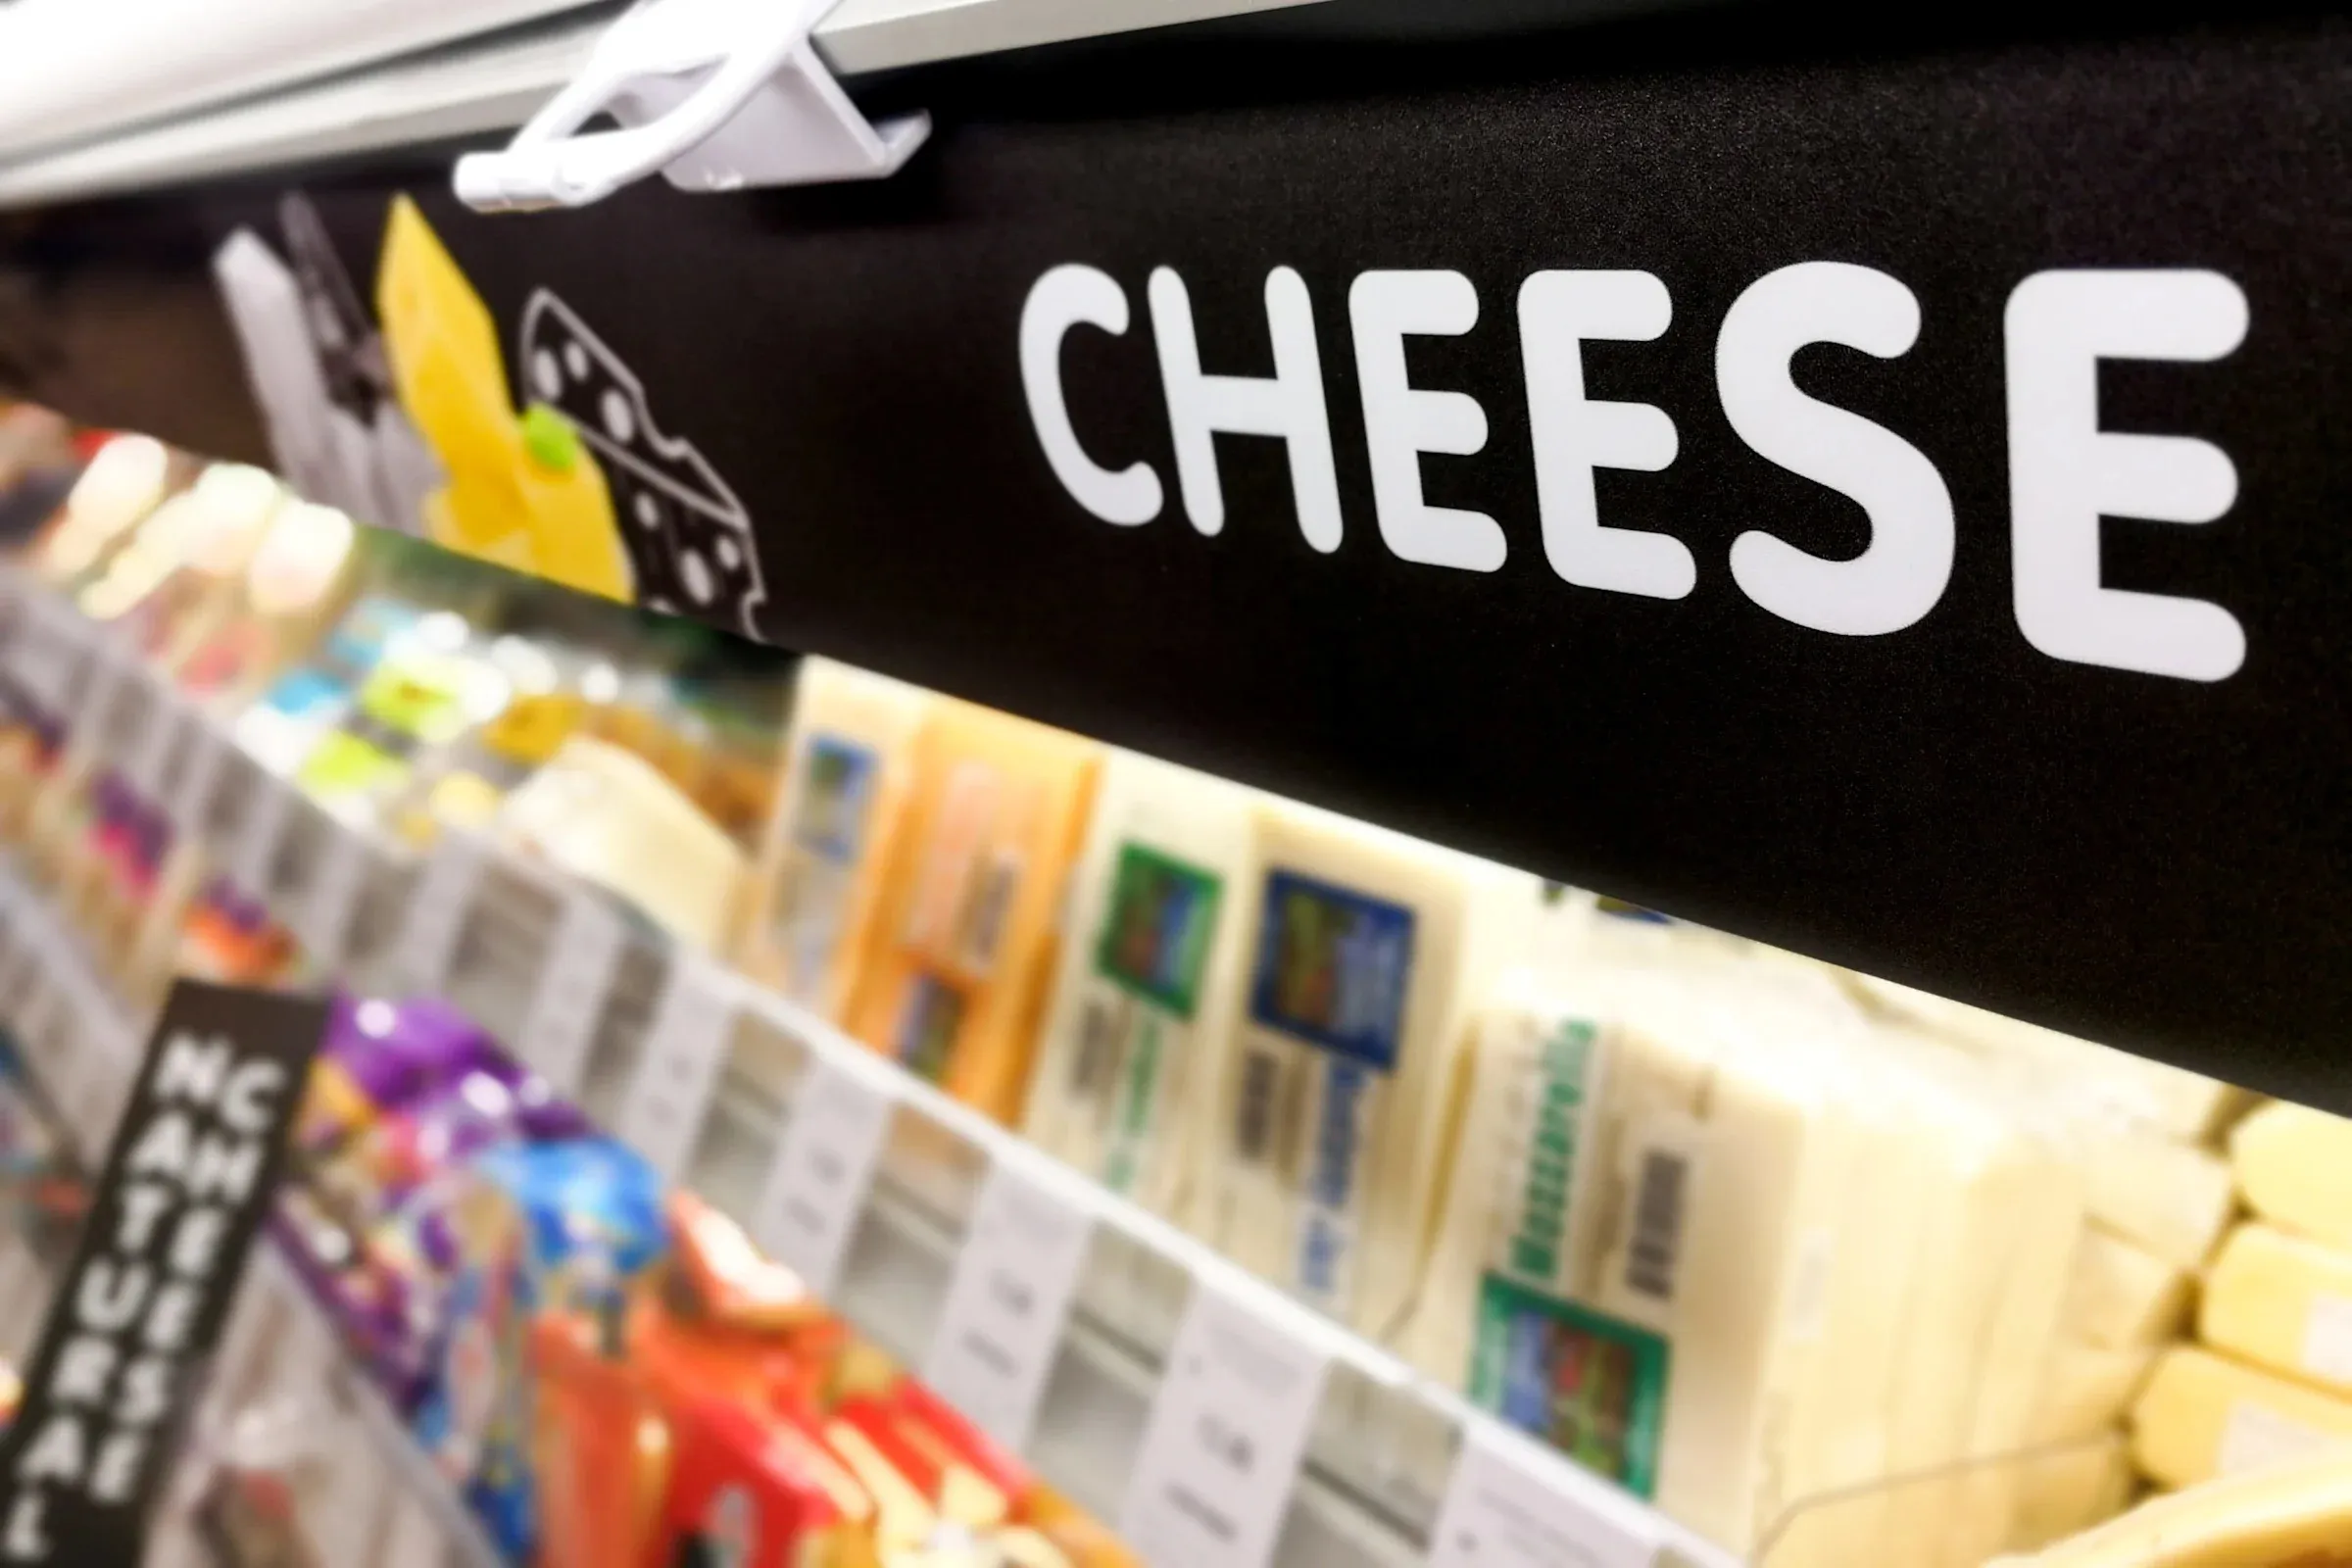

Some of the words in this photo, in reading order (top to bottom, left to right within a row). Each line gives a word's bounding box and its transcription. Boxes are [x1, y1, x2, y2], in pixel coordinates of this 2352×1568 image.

[1019, 261, 2250, 683] CHEESE
[3, 1034, 233, 1559] NATURAL
[88, 1059, 285, 1503] CHEESE
